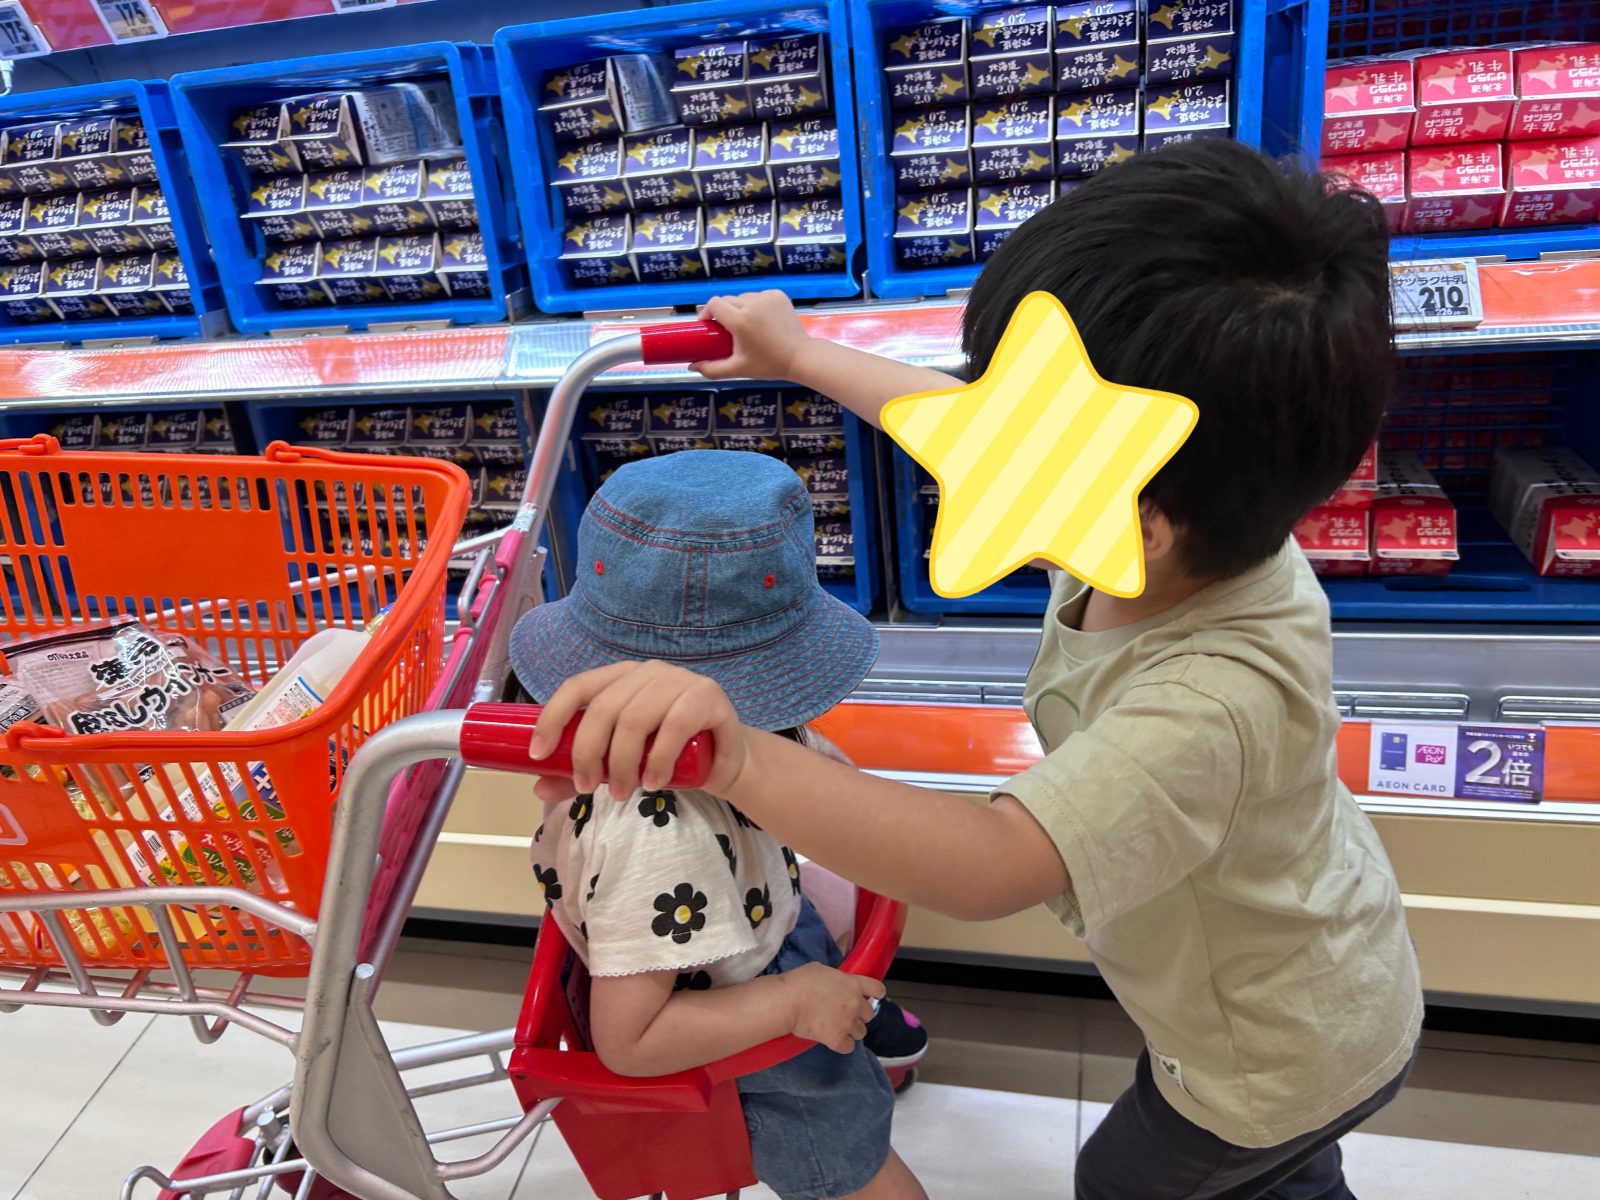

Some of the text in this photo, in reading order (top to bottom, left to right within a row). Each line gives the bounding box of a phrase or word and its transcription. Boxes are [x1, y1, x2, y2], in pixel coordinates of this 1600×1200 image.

[1094, 4, 1114, 15] 2.0
[1168, 2, 1227, 23] まきばの恵み
[1008, 13, 1026, 25] 2.0
[1078, 12, 1134, 32] まきばの恵み
[1182, 19, 1214, 32] 北海道
[923, 24, 942, 36] 2.0
[992, 21, 1045, 41] まきばの恵み
[1090, 29, 1120, 42] 北海道
[905, 32, 962, 52] まきばの恵み
[1000, 38, 1032, 49] 北海道
[915, 49, 947, 61] 北海道
[1166, 42, 1199, 56] 北海道
[1074, 52, 1108, 65] 北海道
[1151, 52, 1208, 71] まきばの恵み
[988, 60, 1021, 73] 北海道
[1062, 59, 1118, 80] まきばの恵み
[905, 71, 935, 83] 北海道
[977, 67, 1032, 88] まきばの恵み
[1171, 69, 1190, 80] 2.0
[1081, 77, 1099, 88] 2.0
[894, 81, 949, 98] まきばの恵み
[997, 84, 1014, 95] 2.0
[1184, 85, 1203, 98] 2.0
[914, 94, 931, 104] 2.0
[1096, 92, 1114, 104] 2.0
[1166, 94, 1226, 113] まきばの恵み
[1011, 101, 1028, 112] 2.0
[1079, 99, 1136, 121] まきばの恵み
[929, 110, 946, 122] 2.0
[992, 109, 1048, 129] まきばの恵み
[1176, 109, 1209, 122] 北海道
[912, 118, 965, 137] まきばの恵み
[1088, 116, 1119, 131] 北海道
[1002, 124, 1033, 138] 北海道
[919, 134, 951, 147] 北海道
[1419, 286, 1463, 308] 210
[1377, 780, 1447, 793] AEON CARD
